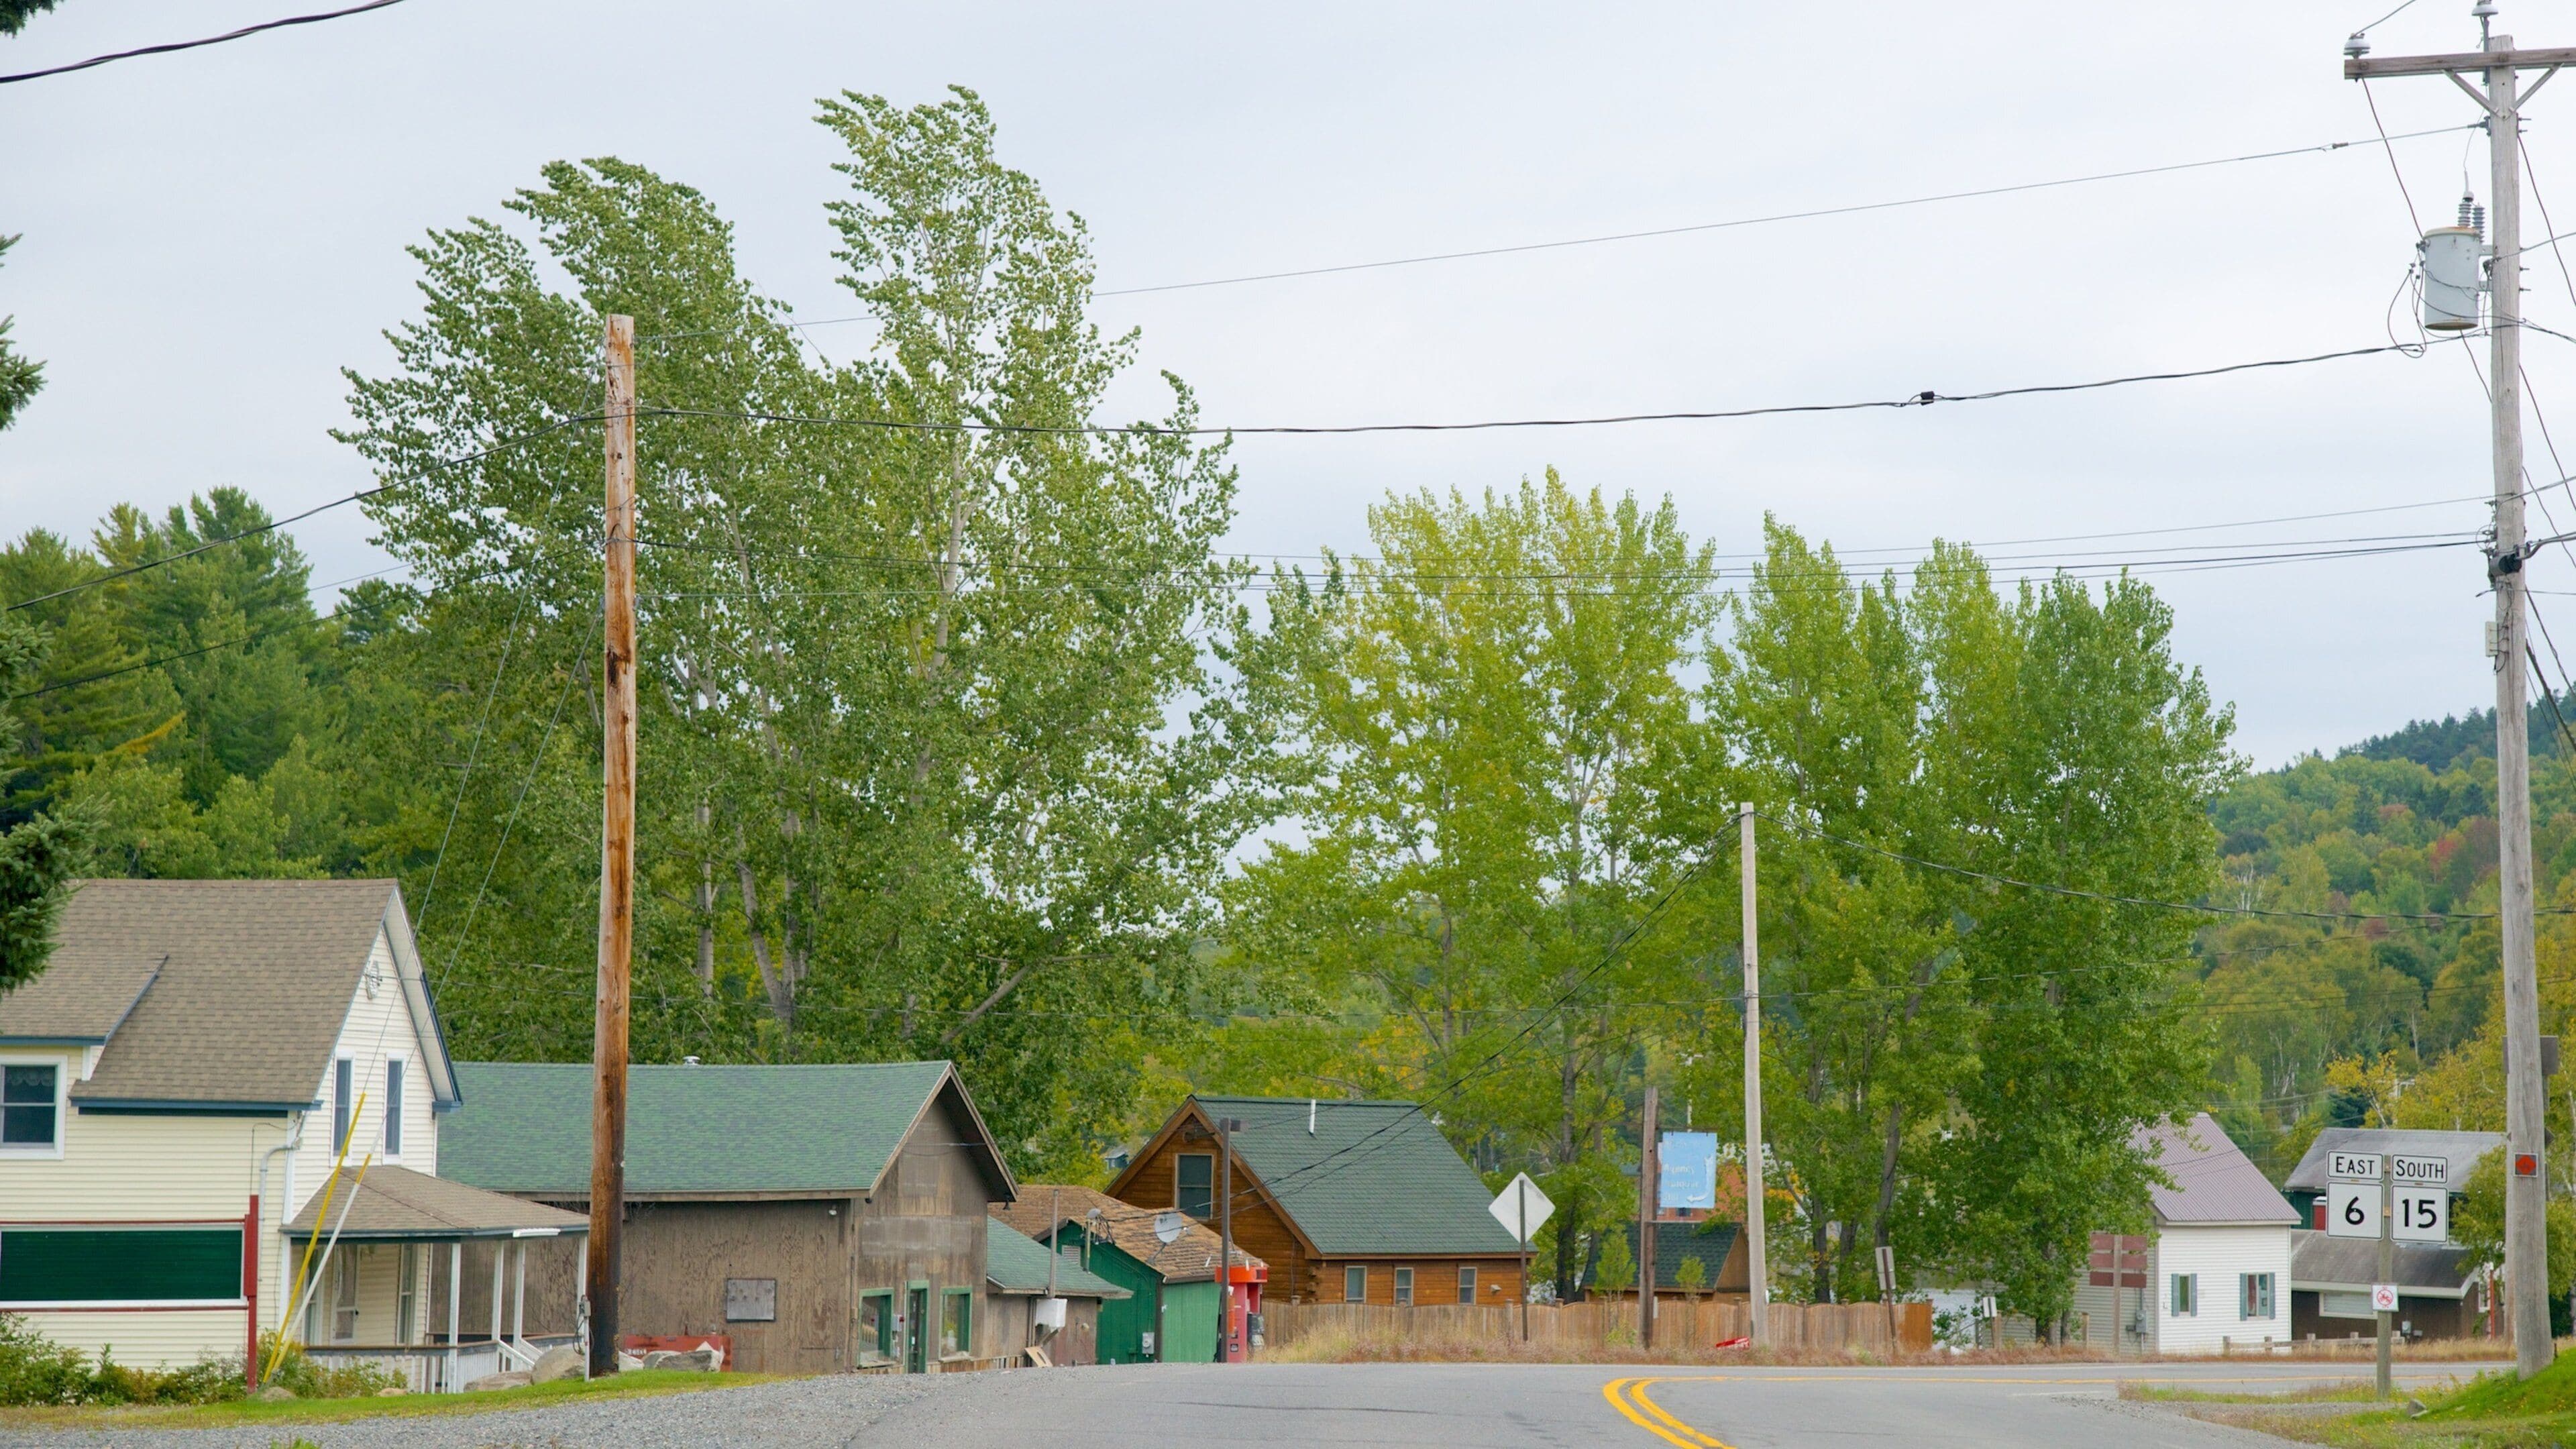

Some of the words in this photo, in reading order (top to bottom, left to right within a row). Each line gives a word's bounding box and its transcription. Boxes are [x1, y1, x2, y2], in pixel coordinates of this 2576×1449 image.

[2336, 1157, 2375, 1174] EAST
[2396, 1159, 2444, 1179] SOUTH
[2345, 1197, 2364, 1225] 6
[2402, 1199, 2436, 1228] 15
